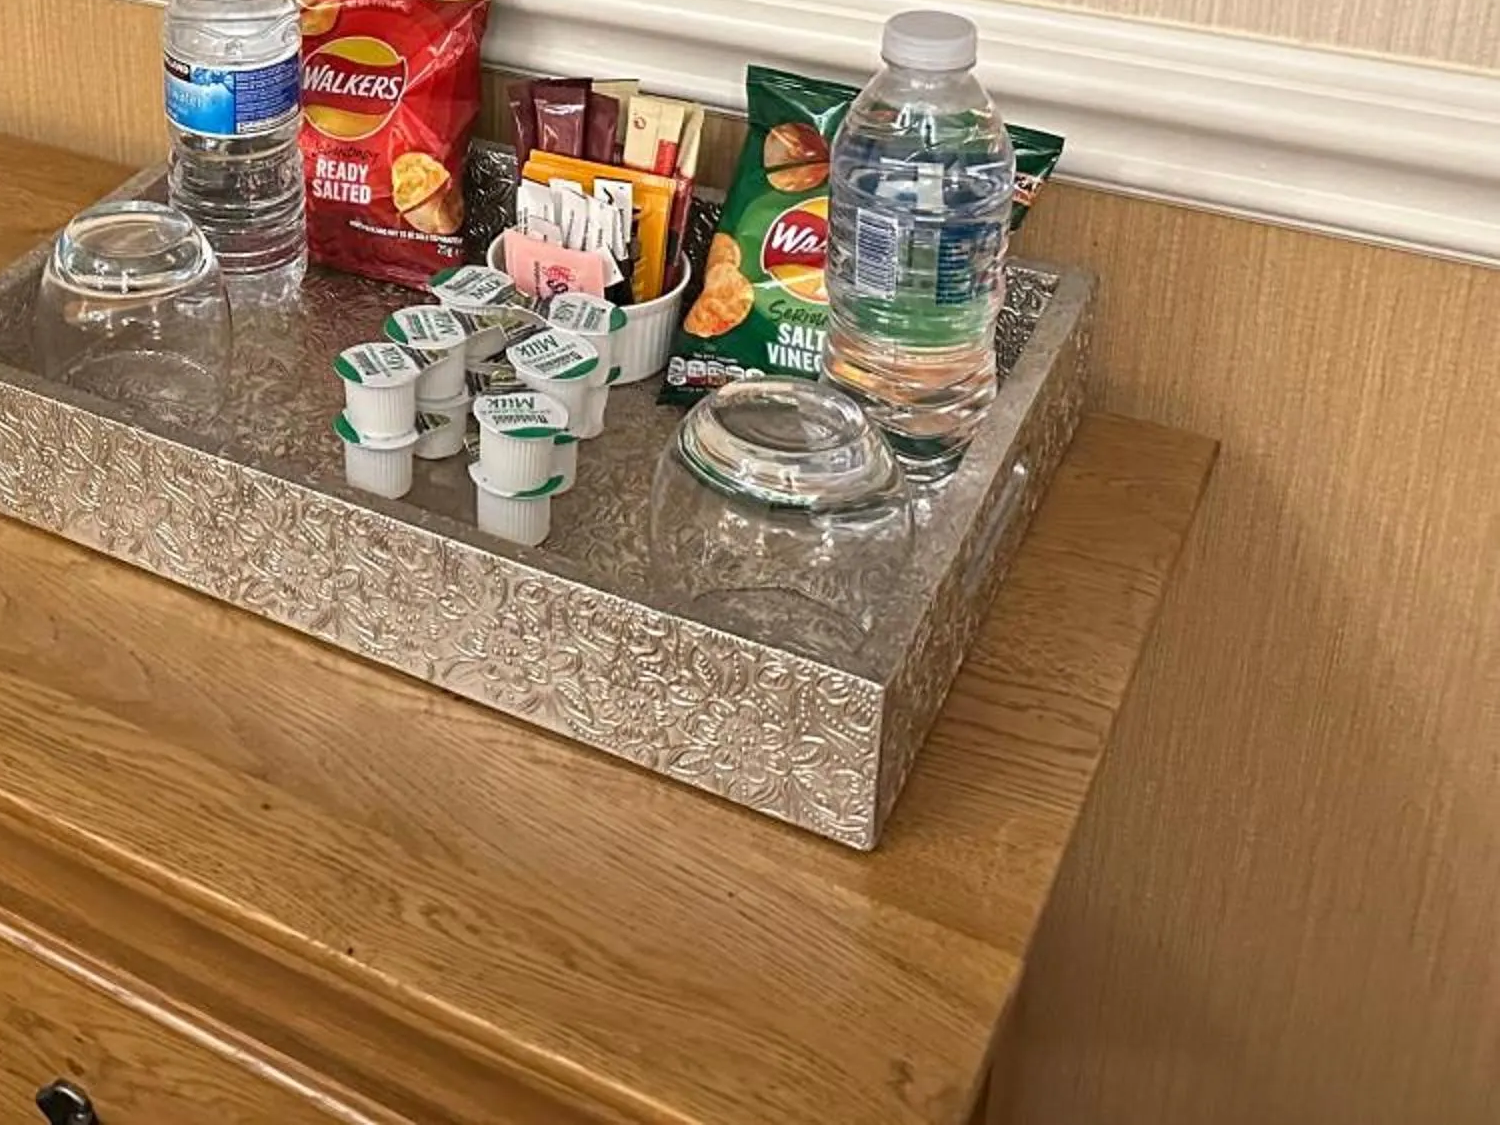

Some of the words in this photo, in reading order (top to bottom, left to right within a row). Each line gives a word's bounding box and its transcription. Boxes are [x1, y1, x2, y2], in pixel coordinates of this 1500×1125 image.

[303, 64, 403, 101] WALKERS
[315, 157, 369, 184] READY
[312, 180, 372, 205] SALTED
[515, 334, 560, 358] Milk
[778, 323, 827, 352] SALT
[485, 396, 535, 410] Milk
